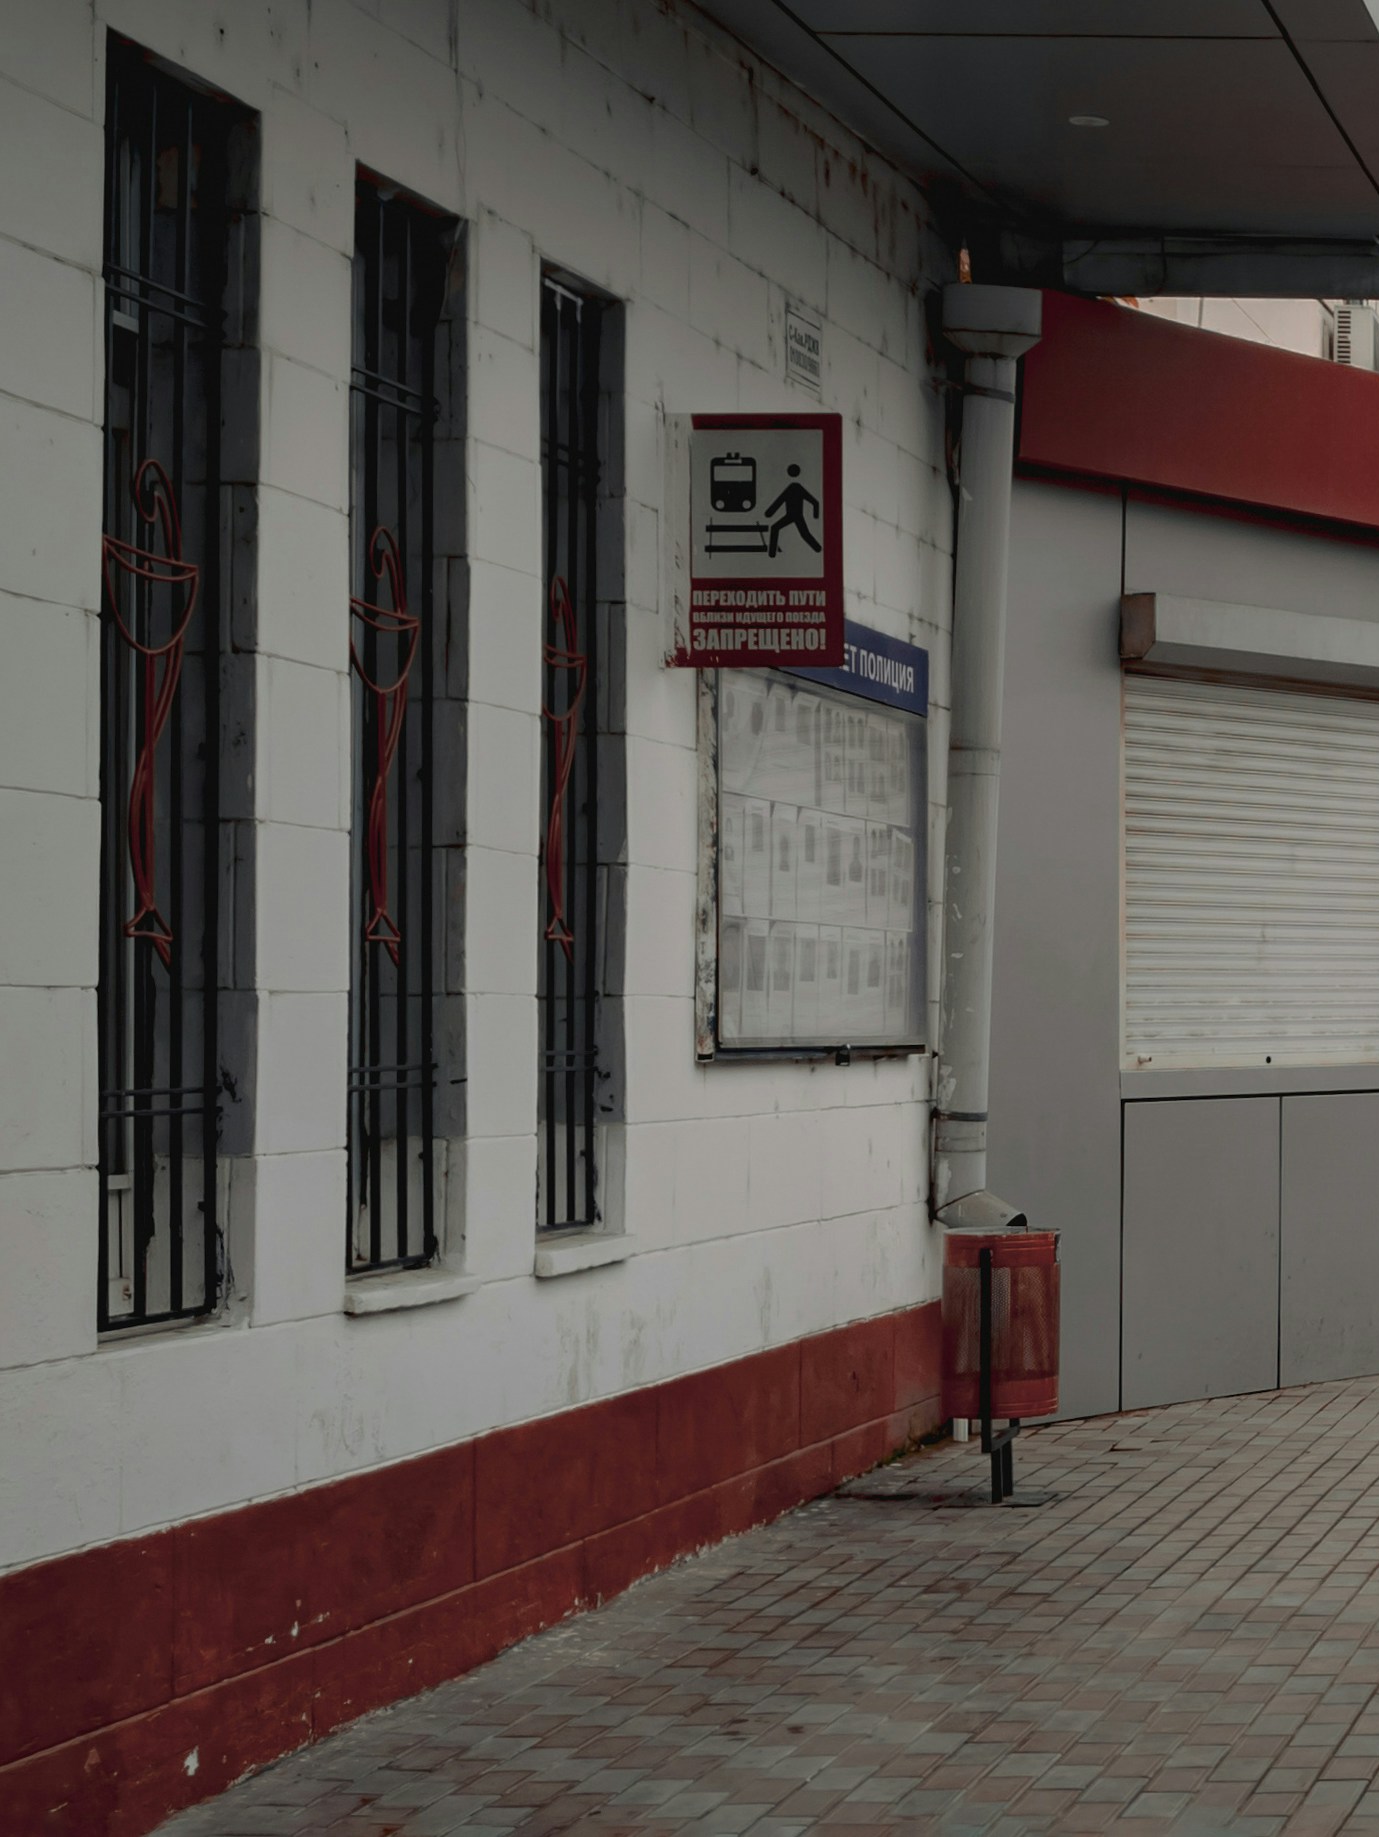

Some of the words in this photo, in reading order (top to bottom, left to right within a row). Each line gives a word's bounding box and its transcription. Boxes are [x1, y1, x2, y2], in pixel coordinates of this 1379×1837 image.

[692, 590, 786, 608] ПЕРЕХОДИТЬ
[788, 590, 826, 606] ПУТИ
[692, 611, 734, 623] ВБЛИЗИ
[735, 611, 783, 624] ИДУЩЕГО
[785, 611, 826, 624] ПОЕЗДА
[692, 628, 826, 653] ЗАПРЕЩЕНО!
[860, 648, 914, 694] ПОЛИЦИЯ
